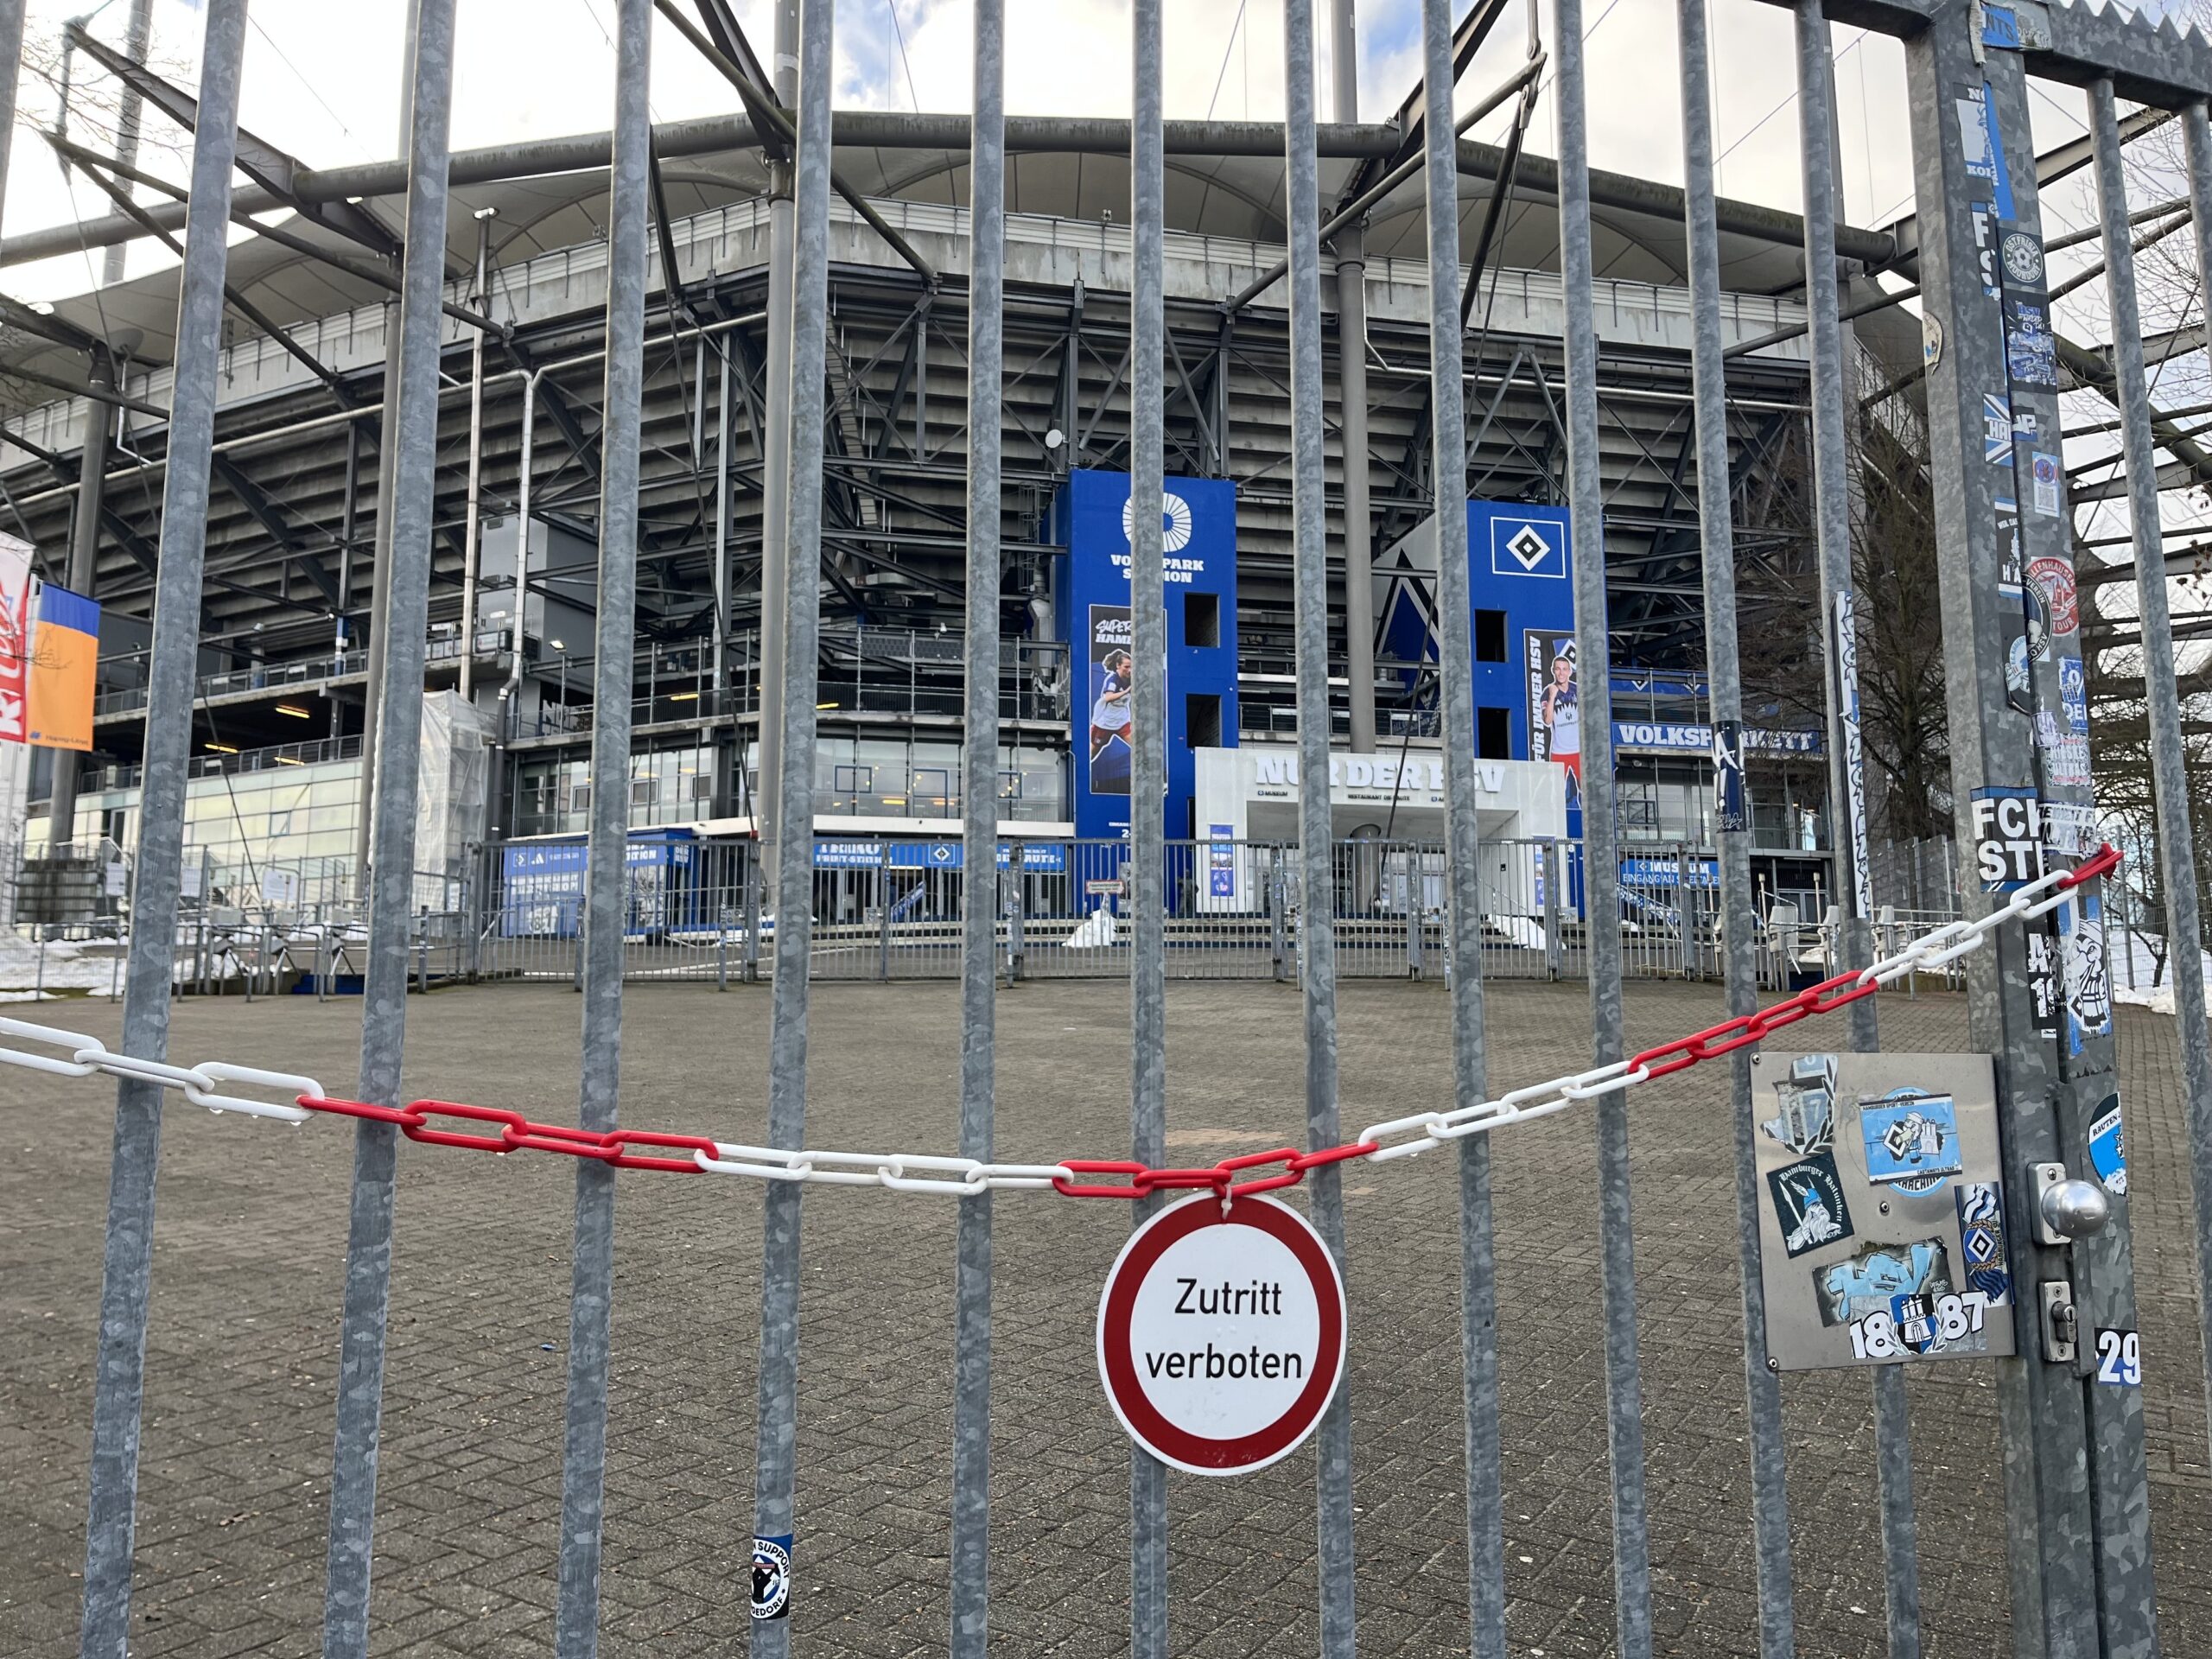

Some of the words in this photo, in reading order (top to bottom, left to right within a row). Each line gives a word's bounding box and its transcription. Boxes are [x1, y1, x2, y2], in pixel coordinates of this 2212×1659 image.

[1110, 554, 1205, 571] VOPARK
[1122, 568, 1192, 583] SION
[1529, 635, 1541, 671] HSV
[1531, 671, 1544, 729] IMMER
[1346, 760, 1422, 790] DER
[1428, 762, 1505, 792] HV
[1649, 861, 1709, 874] MUSUM
[2092, 1114, 2117, 1136] RAUTEN
[1778, 1164, 1824, 1183] Hamburger
[1174, 1277, 1282, 1315] Zutritt
[1145, 1343, 1302, 1379] verboten
[2098, 1330, 2141, 1385] 29
[758, 1541, 790, 1579] SUPPORT
